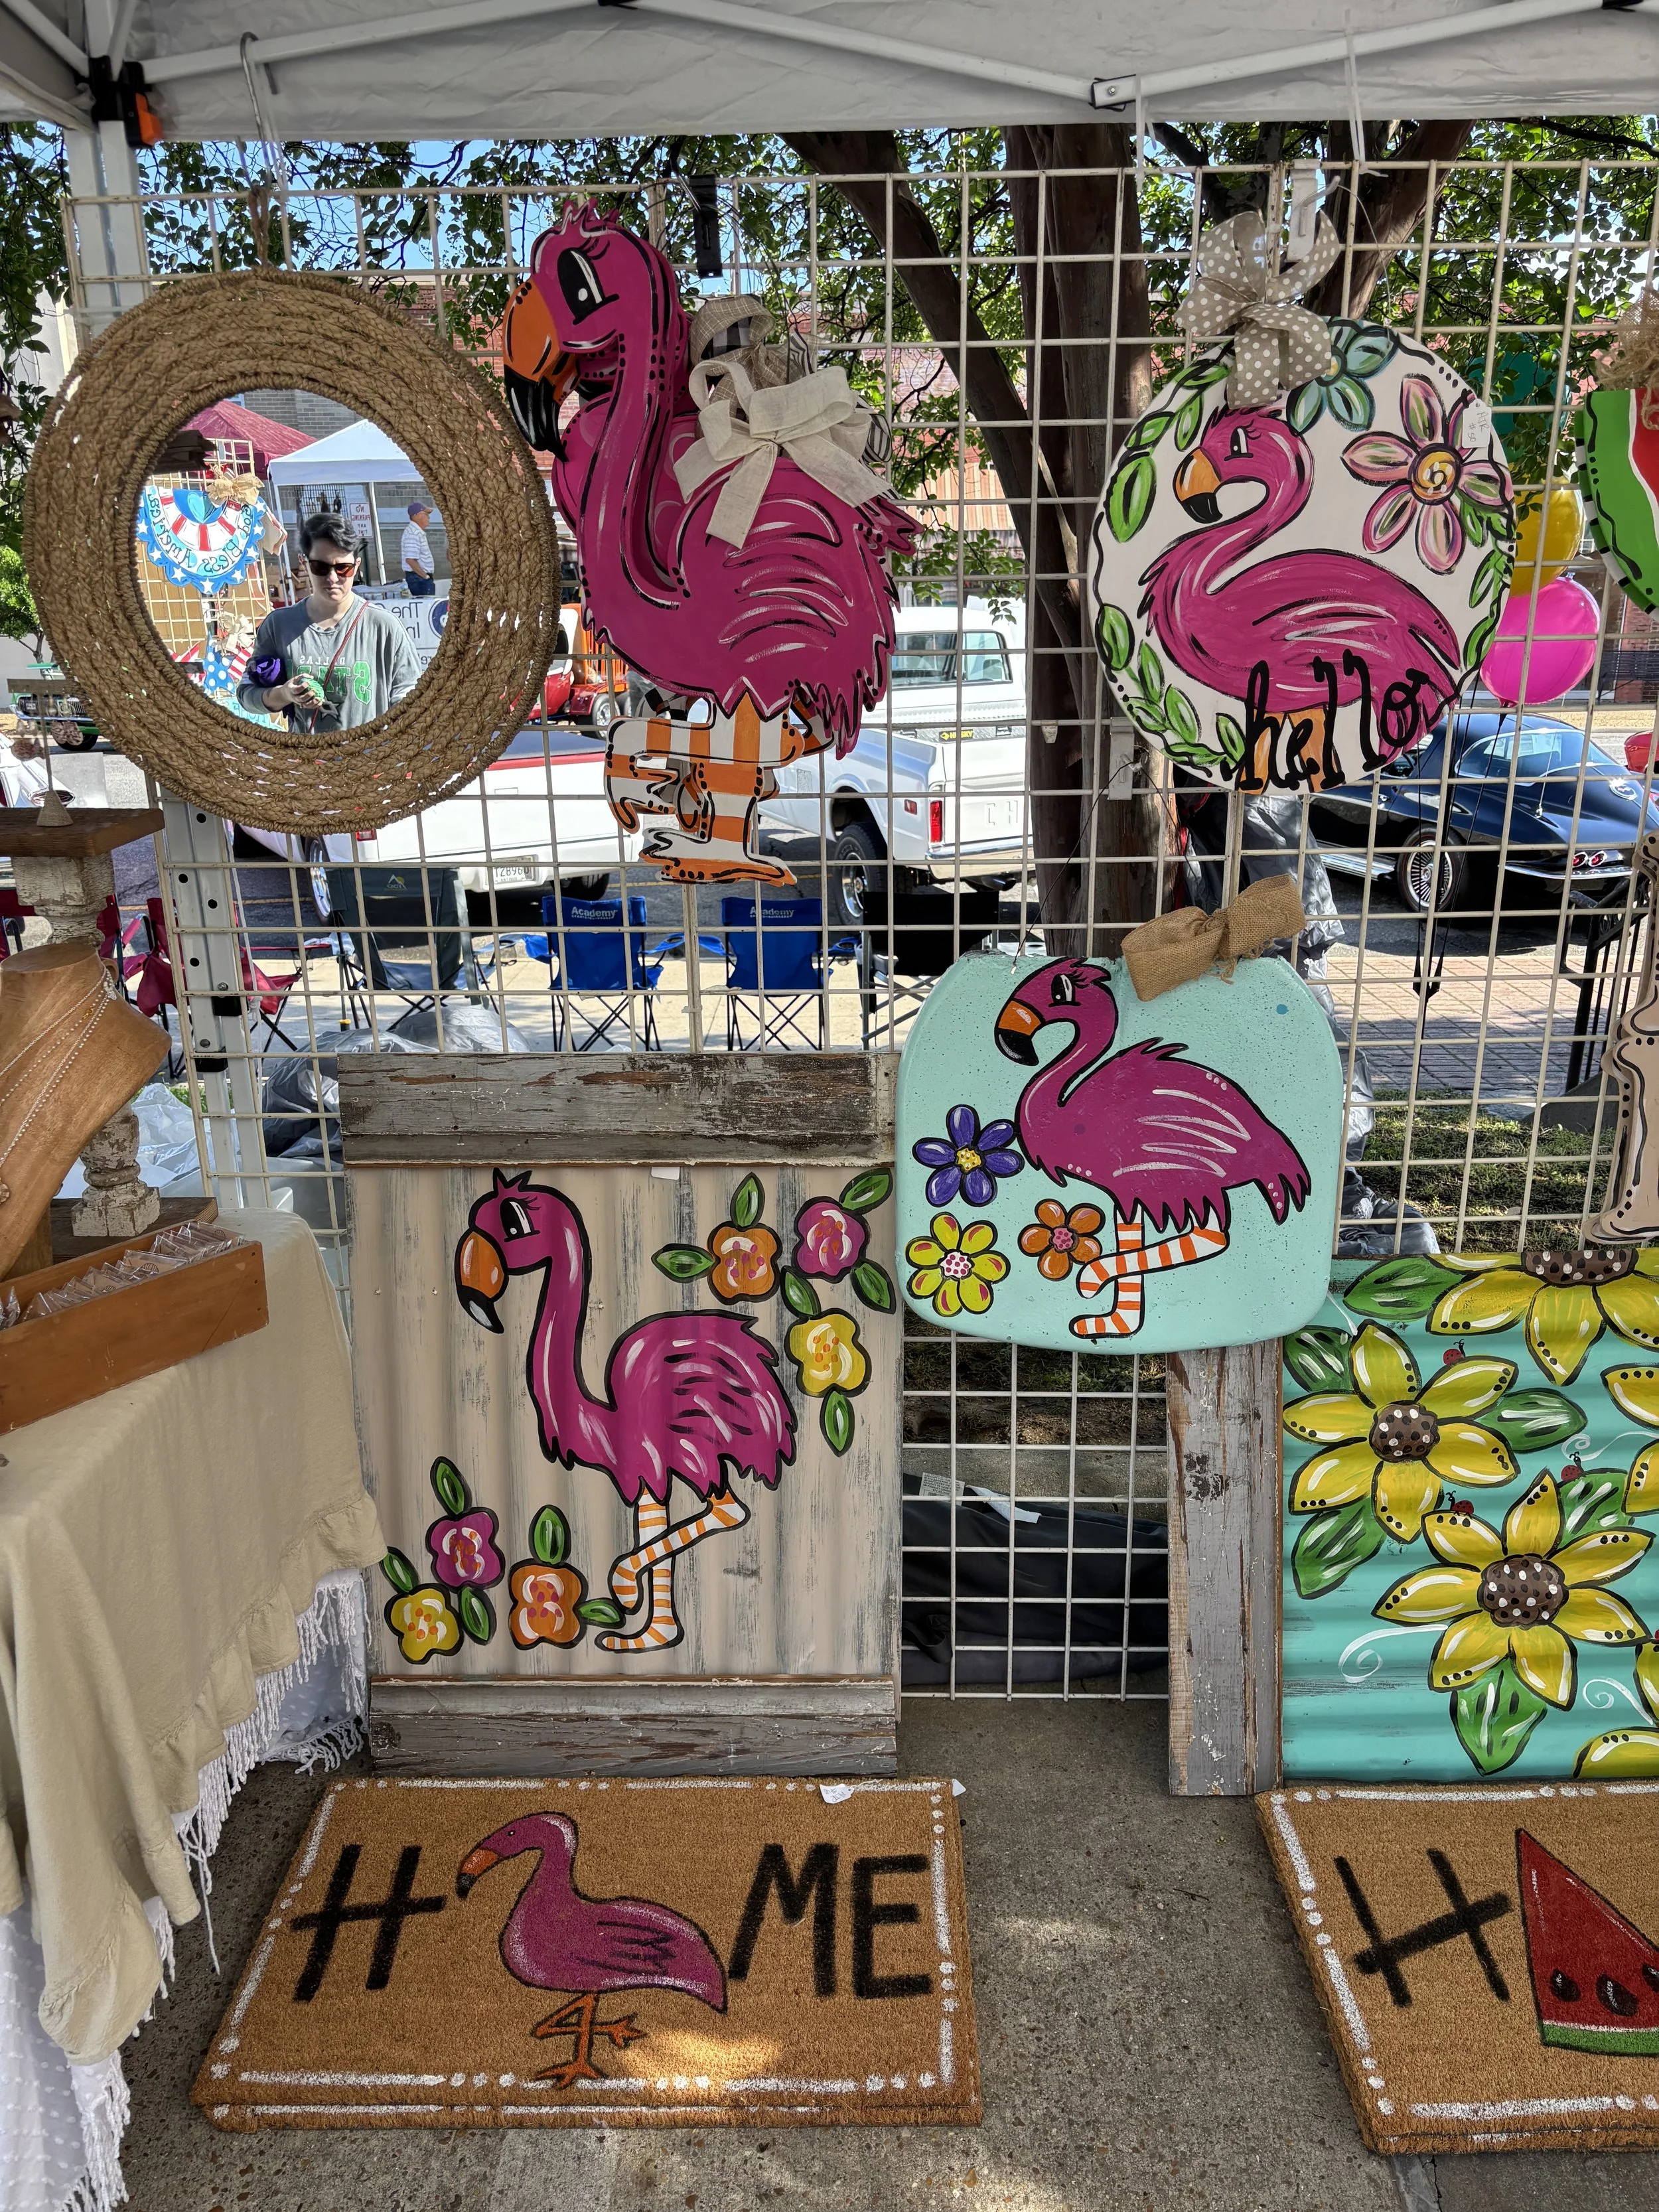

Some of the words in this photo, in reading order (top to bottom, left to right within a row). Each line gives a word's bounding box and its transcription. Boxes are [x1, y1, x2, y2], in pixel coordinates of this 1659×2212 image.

[1237, 648, 1430, 791] hello
[949, 730, 973, 739] HSKY
[571, 907, 616, 919] Academy
[750, 907, 794, 917] Aademy
